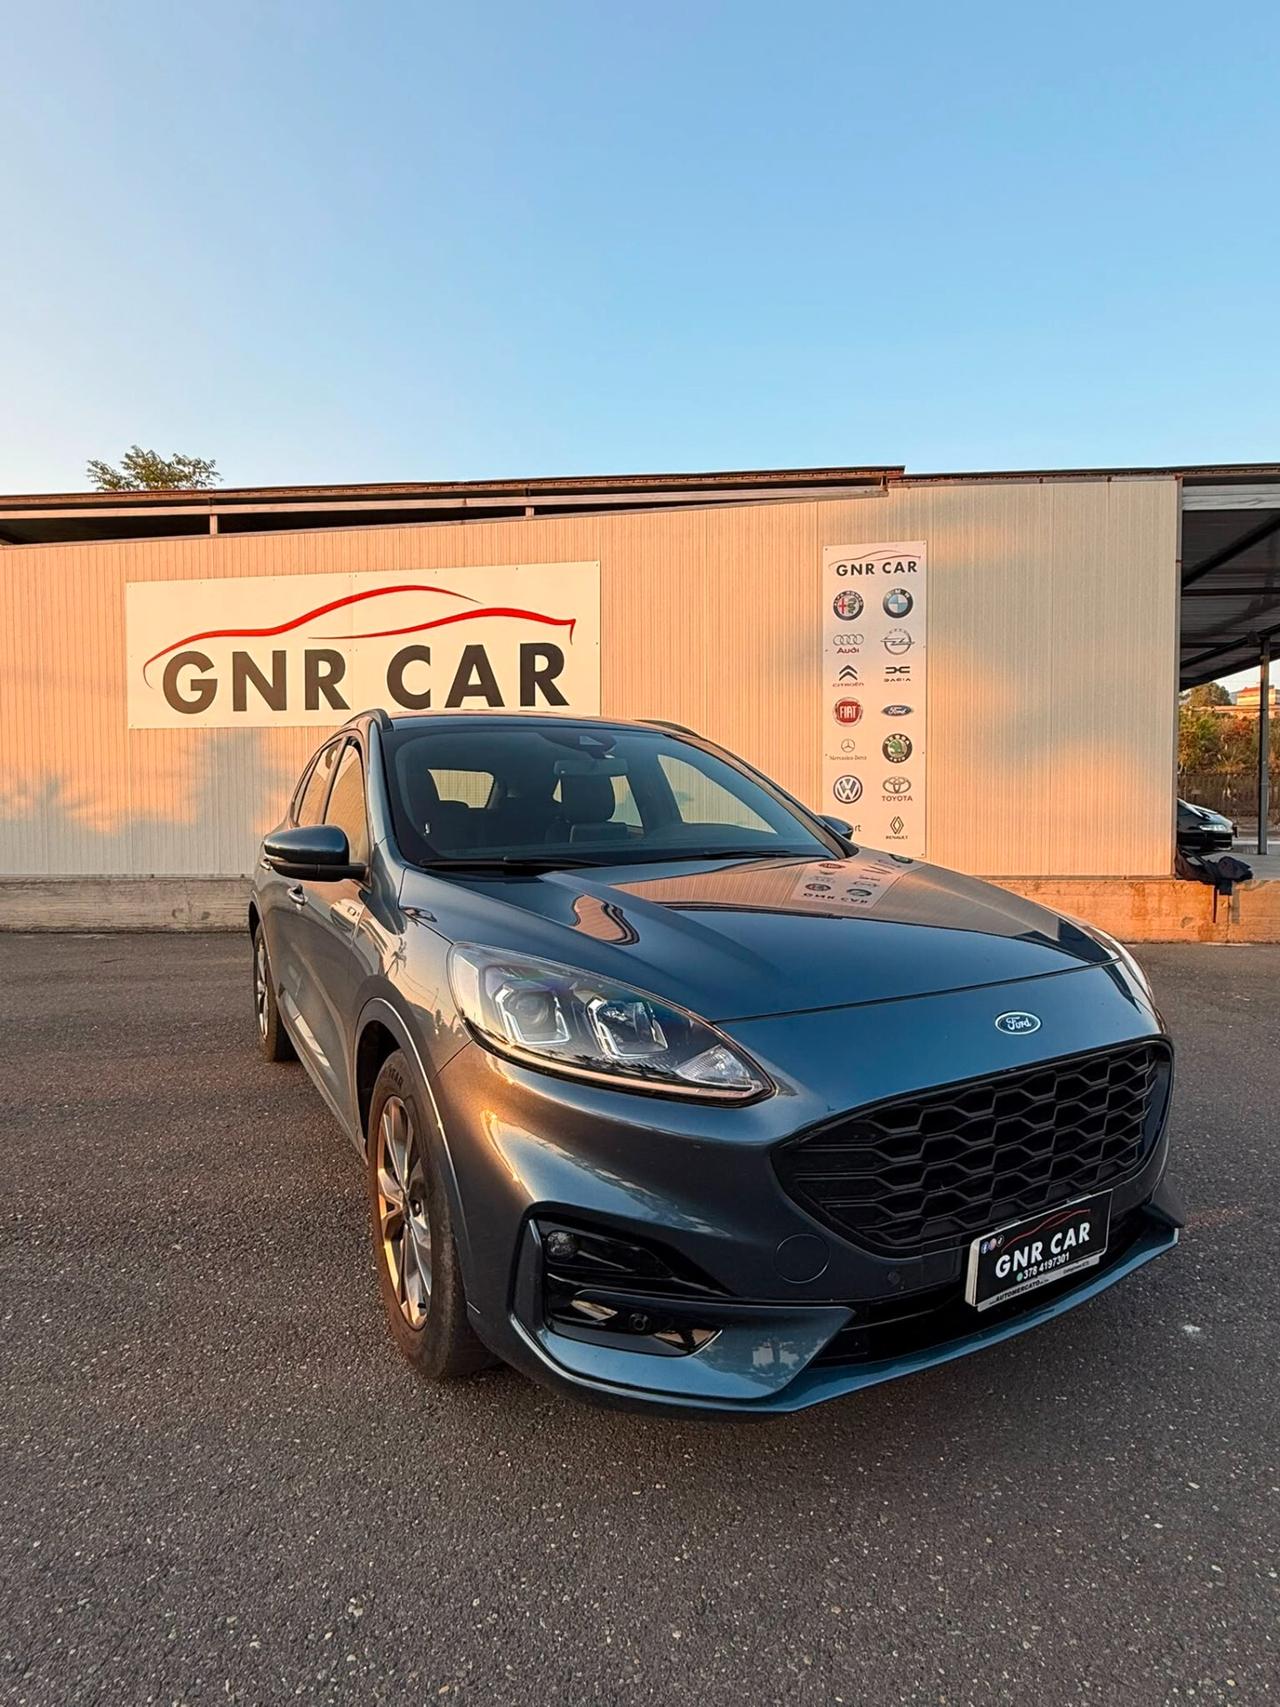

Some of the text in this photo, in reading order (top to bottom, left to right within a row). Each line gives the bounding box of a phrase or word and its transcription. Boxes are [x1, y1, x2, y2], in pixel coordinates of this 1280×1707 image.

[836, 561, 917, 577] GNR CAR
[162, 642, 570, 714] GNR CAR
[840, 705, 857, 719] FIAT
[887, 706, 907, 715] Ford
[1005, 1016, 1032, 1031] Ford
[995, 1222, 1091, 1278] GNR CAR
[1023, 1265, 1038, 1280] 378
